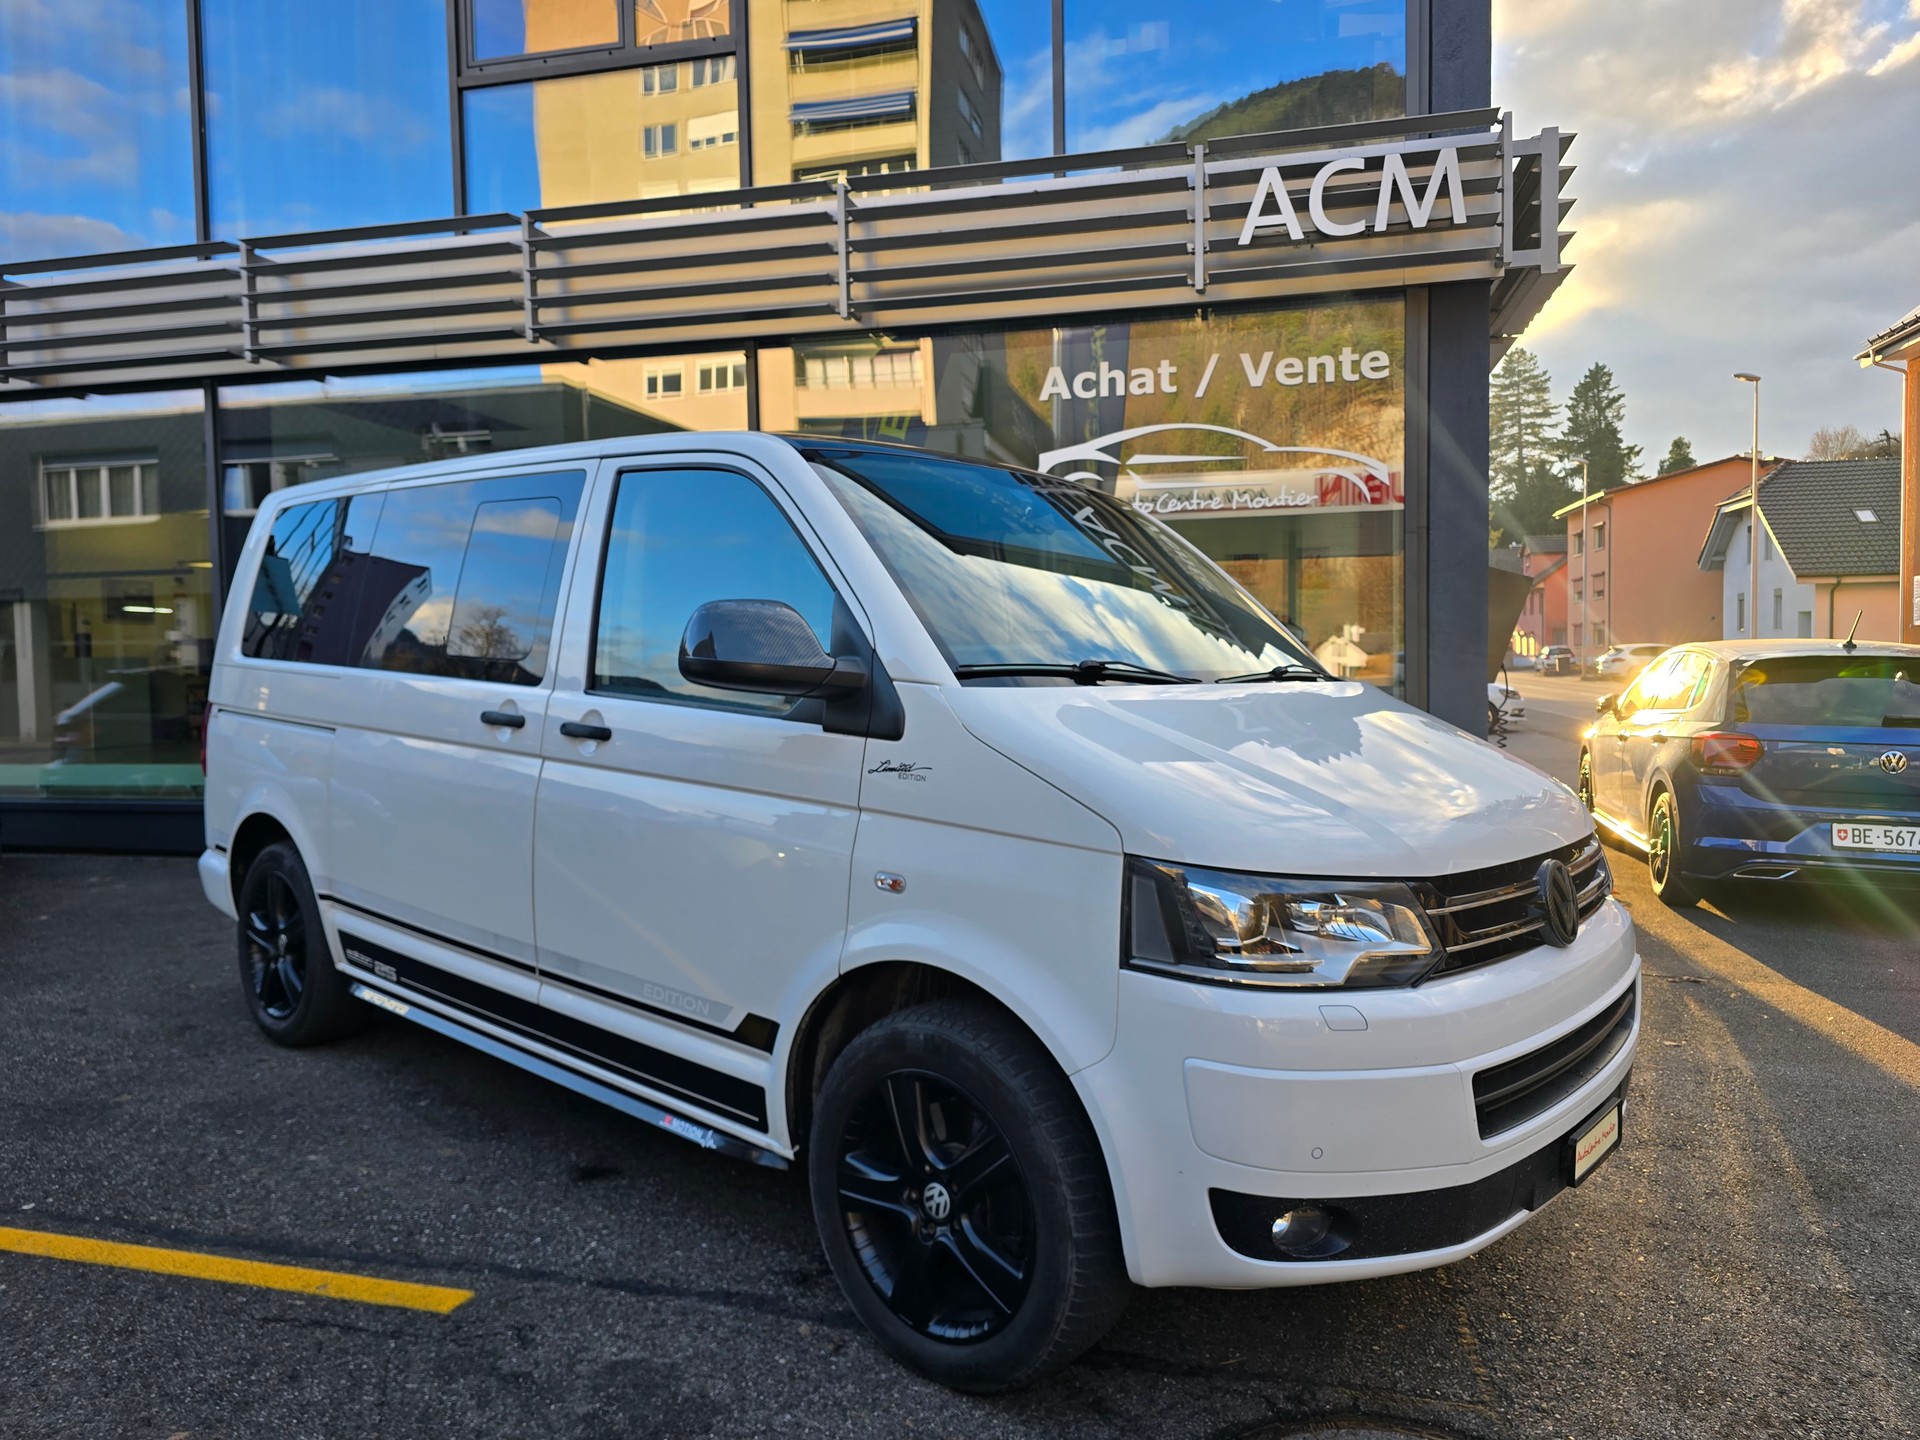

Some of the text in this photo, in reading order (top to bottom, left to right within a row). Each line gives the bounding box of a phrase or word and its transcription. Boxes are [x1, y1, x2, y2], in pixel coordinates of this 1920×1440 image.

[1238, 147, 1468, 245] ACM
[1039, 346, 1391, 401] Achat / Vente
[1232, 485, 1319, 510] Moutier
[898, 772, 927, 782] EDITION
[642, 983, 711, 1016] EDITION
